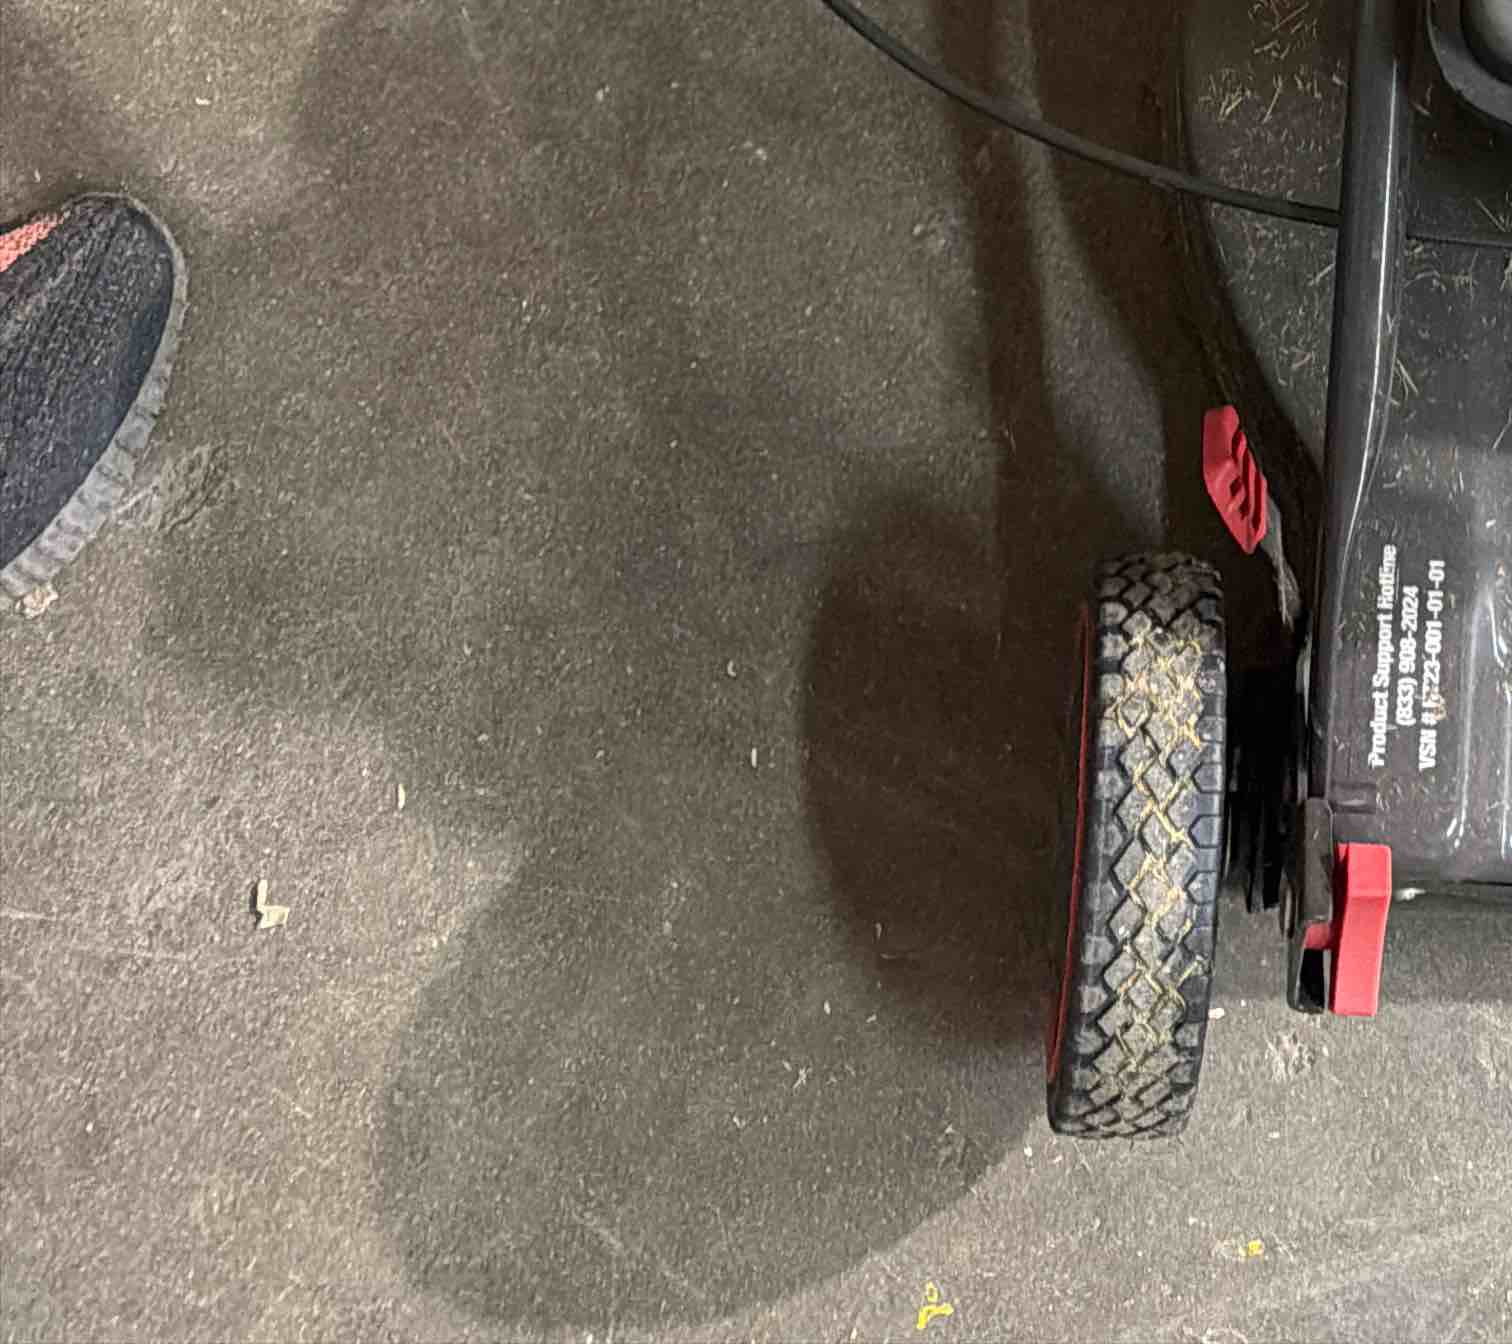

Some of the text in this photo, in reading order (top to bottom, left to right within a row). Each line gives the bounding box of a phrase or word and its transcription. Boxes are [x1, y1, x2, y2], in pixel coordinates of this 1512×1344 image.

[1372, 613, 1394, 688] Support
[1396, 585, 1419, 726] (833) 908-2024
[1369, 690, 1388, 769] Product
[1419, 729, 1437, 771] VSN
